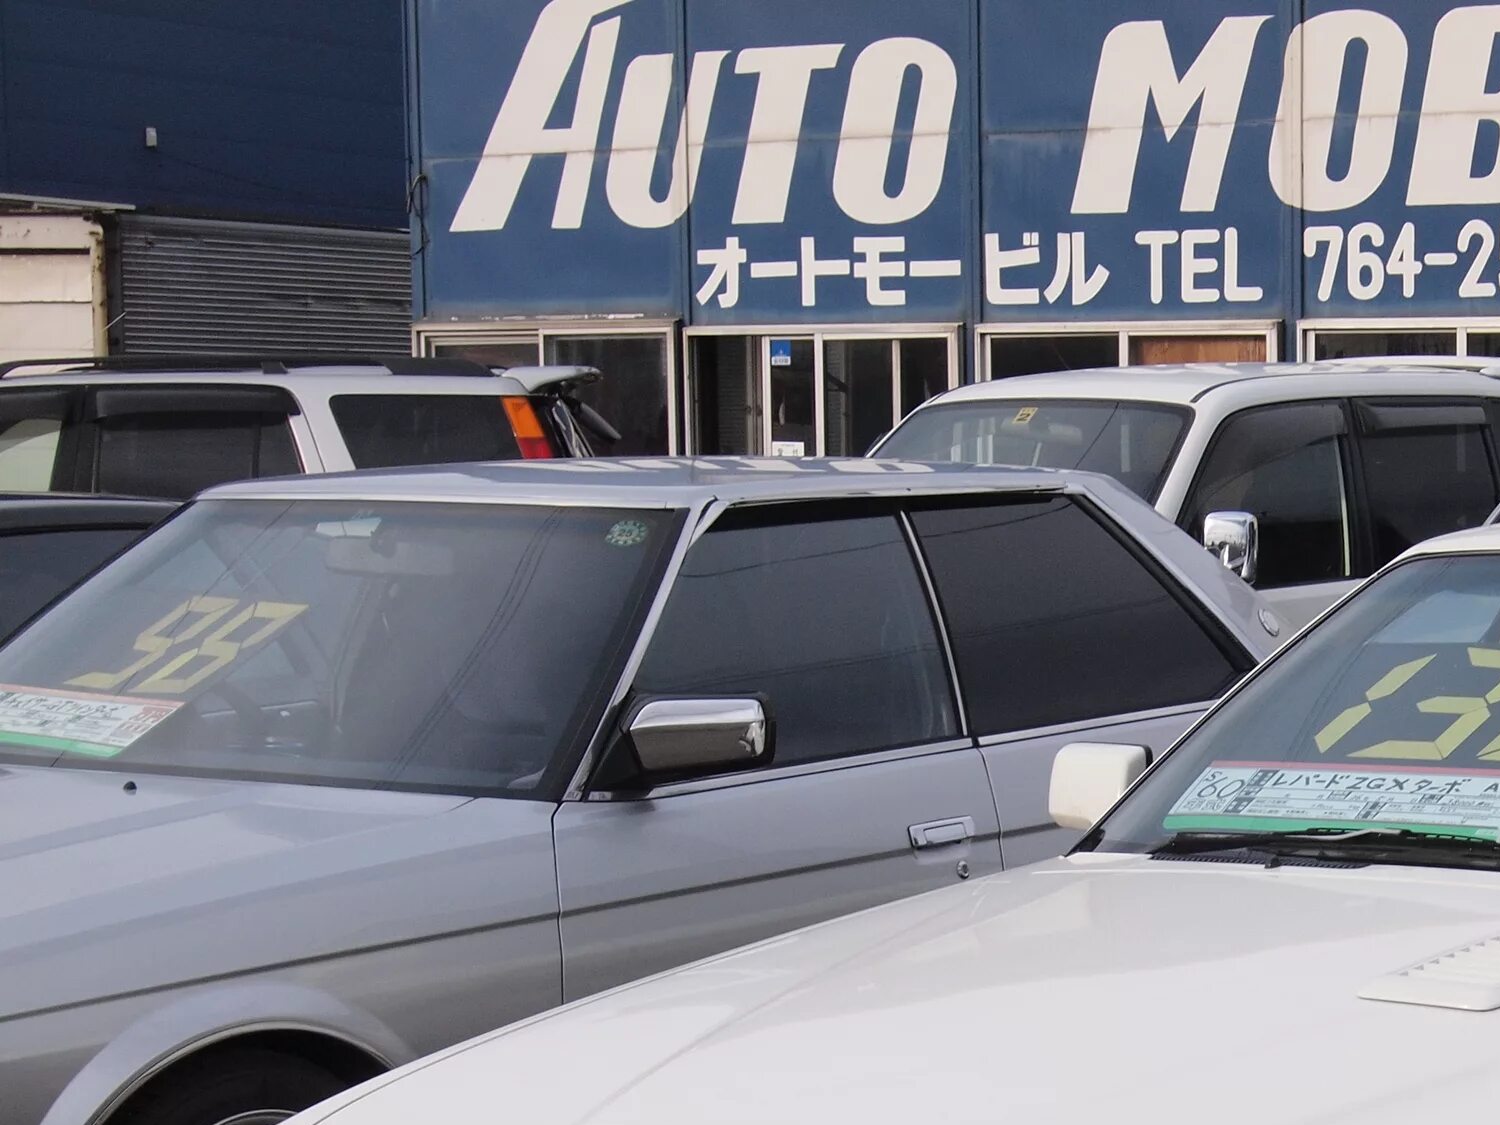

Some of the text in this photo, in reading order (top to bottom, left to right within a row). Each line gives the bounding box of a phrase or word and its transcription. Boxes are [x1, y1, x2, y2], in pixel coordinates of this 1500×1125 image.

[450, 0, 957, 232] AUTO
[696, 230, 1110, 309] オートモービル
[1134, 229, 1263, 303] TEL
[63, 597, 310, 694] 98
